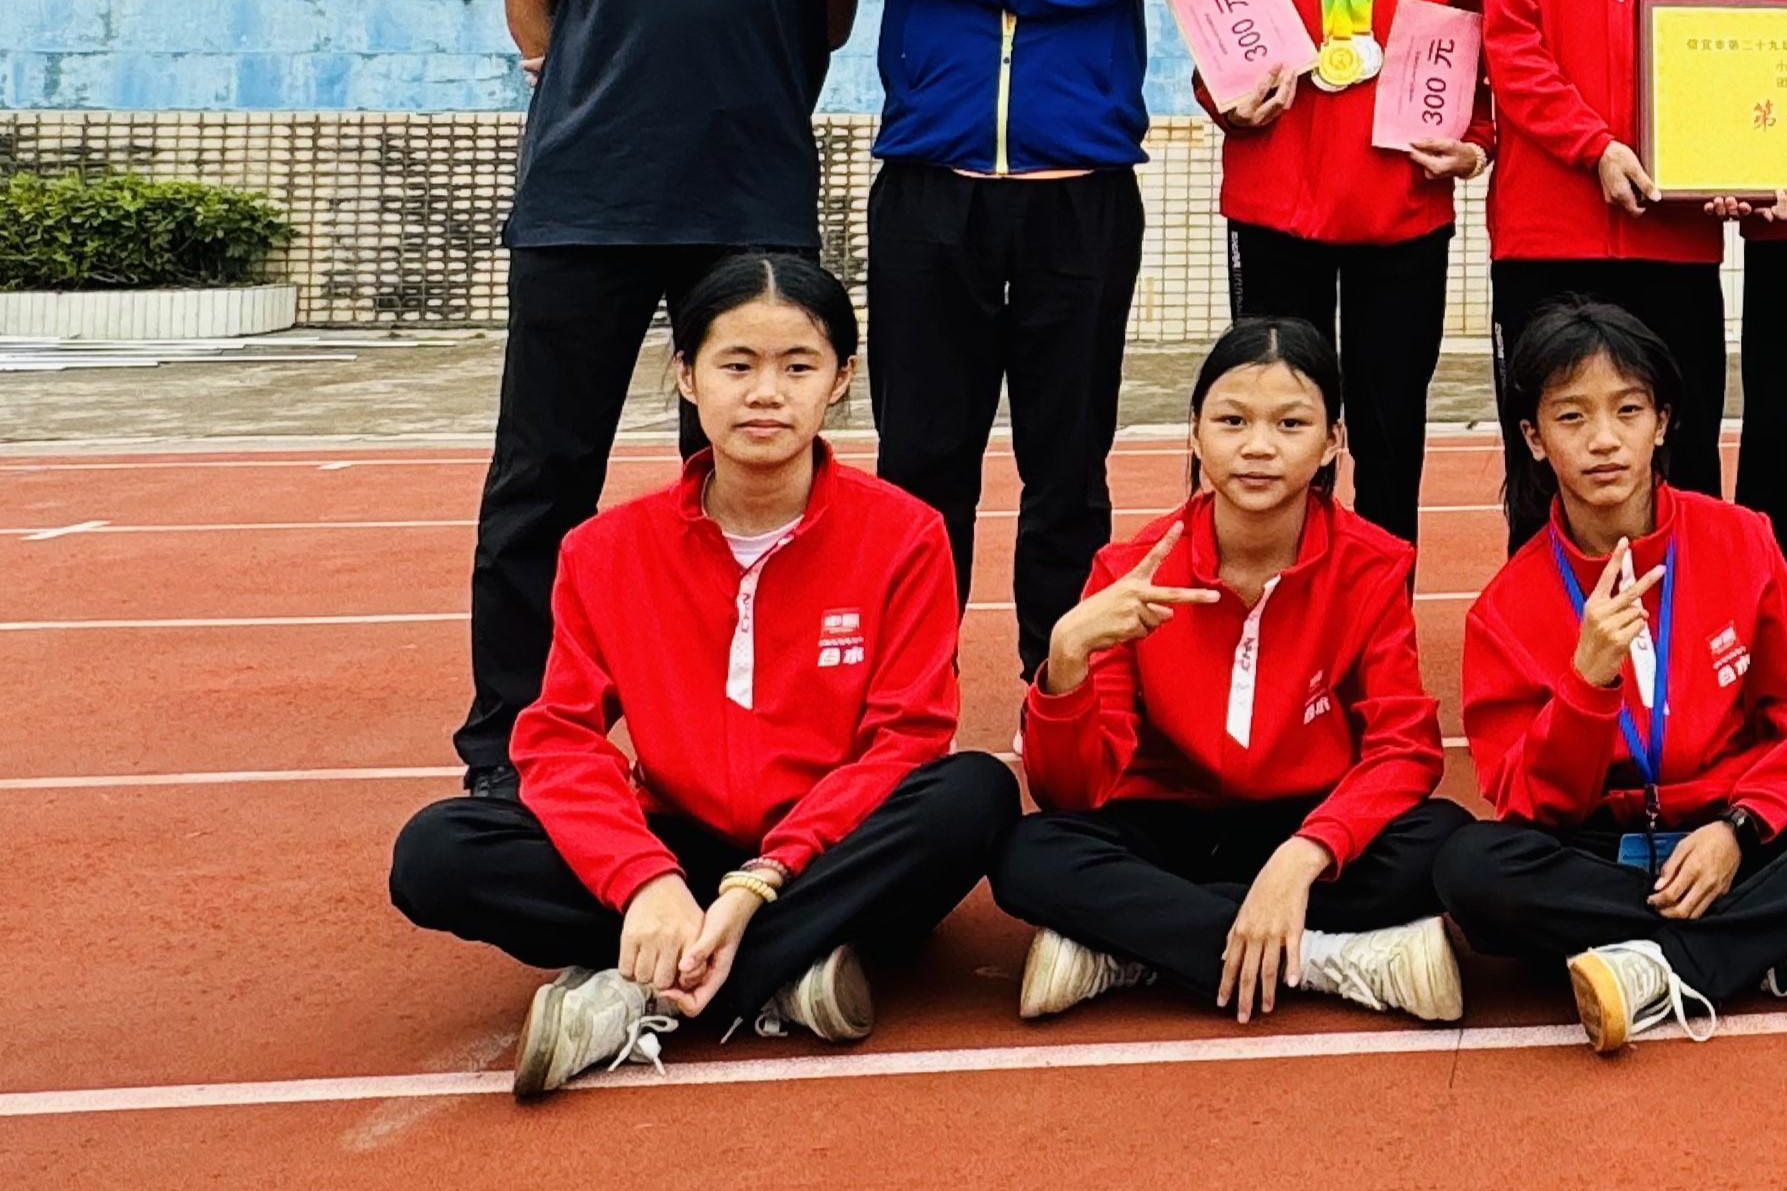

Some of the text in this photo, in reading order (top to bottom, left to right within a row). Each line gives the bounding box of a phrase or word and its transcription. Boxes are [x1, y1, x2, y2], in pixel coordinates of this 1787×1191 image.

[1232, 19, 1268, 62] 300
[1422, 39, 1455, 125] 300 元
